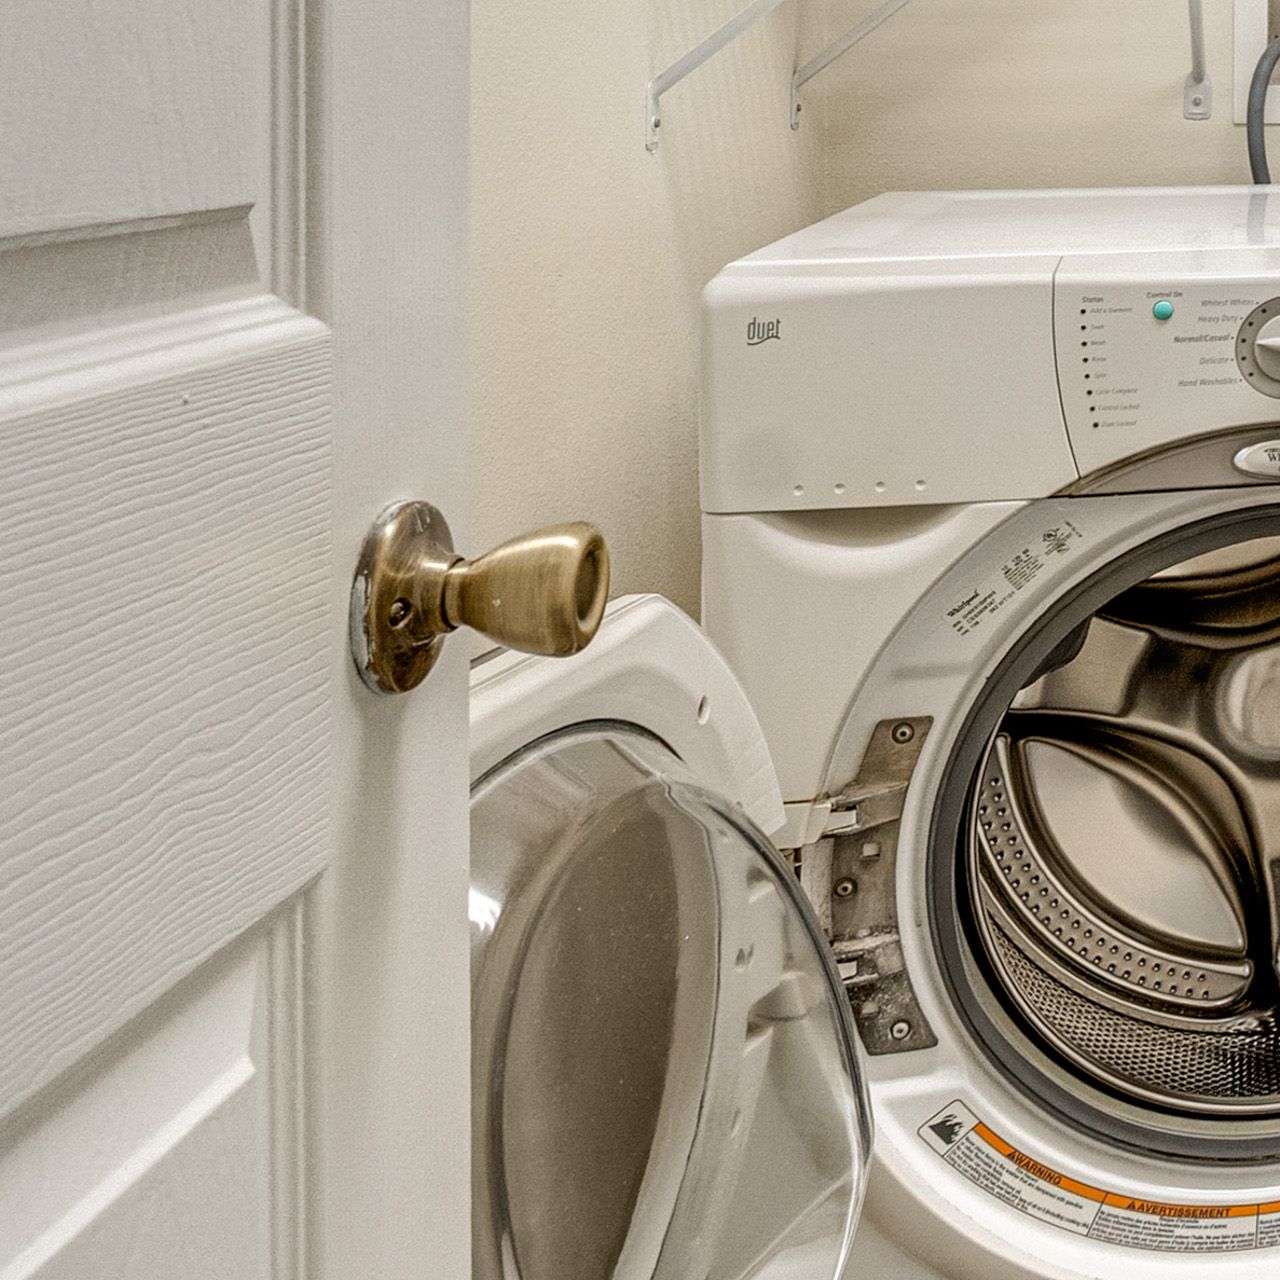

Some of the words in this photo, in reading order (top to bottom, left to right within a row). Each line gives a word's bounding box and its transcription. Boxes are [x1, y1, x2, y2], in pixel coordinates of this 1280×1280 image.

[747, 317, 781, 343] duet
[1014, 1152, 1061, 1185] WARNING
[1137, 1202, 1231, 1218] AVERTISSEMENT
